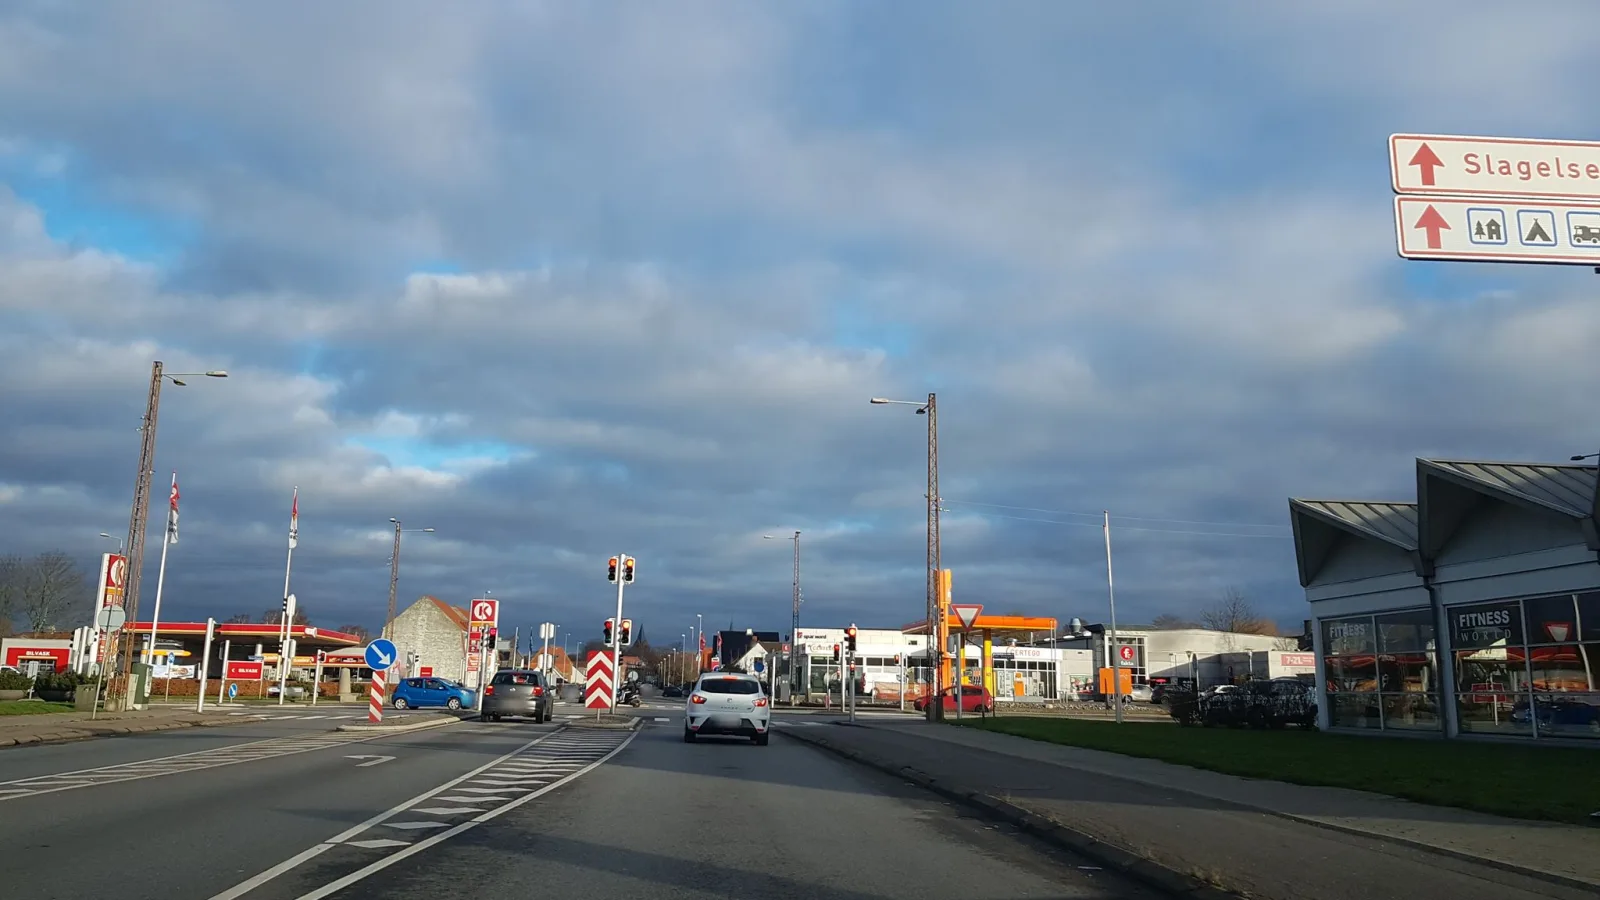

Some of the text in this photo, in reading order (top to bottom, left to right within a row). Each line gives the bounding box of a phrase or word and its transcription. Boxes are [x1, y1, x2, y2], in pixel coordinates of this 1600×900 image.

[1464, 153, 1600, 181] Slagelse
[1459, 610, 1510, 627] FITNESS
[1461, 629, 1511, 642] WORLD
